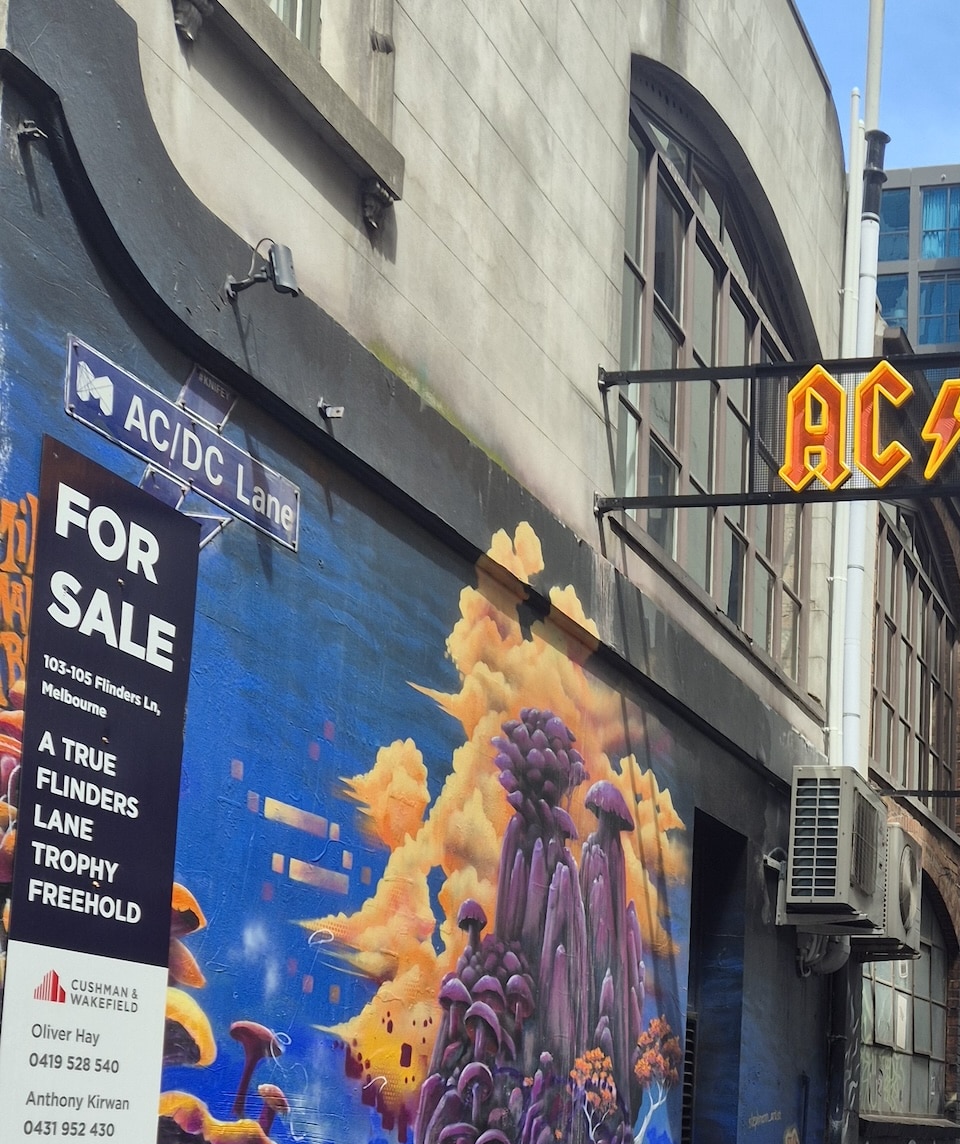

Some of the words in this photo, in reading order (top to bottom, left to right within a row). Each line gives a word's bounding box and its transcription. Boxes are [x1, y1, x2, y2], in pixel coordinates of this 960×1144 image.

[124, 394, 224, 487] AC/DC
[236, 463, 295, 531] Lane
[55, 481, 160, 585] FOR
[47, 570, 177, 673] SALE
[41, 680, 108, 719] Melbourne
[43, 654, 93, 686] 103-105
[94, 675, 142, 706] Flinders
[143, 695, 161, 716] Ln,
[38, 731, 56, 756] A
[61, 737, 117, 777] TRUE
[36, 766, 139, 819] FLINDERS
[34, 803, 94, 842] LANE
[31, 841, 119, 884] TROPHY
[28, 878, 142, 924] FREEHOLD
[70, 993, 139, 1013] WAKEFIELD
[71, 979, 128, 999] CUSHMAN
[131, 988, 139, 999] &
[31, 1023, 72, 1042] Oliver
[75, 1028, 100, 1047] Hay
[29, 1052, 63, 1070] 0419
[66, 1056, 91, 1072] 528
[94, 1058, 120, 1074] 540
[25, 1091, 84, 1111] Anthony
[87, 1094, 130, 1111] Kirwan
[23, 1120, 58, 1136] 0431
[61, 1122, 86, 1137] 952
[89, 1123, 115, 1137] 430
